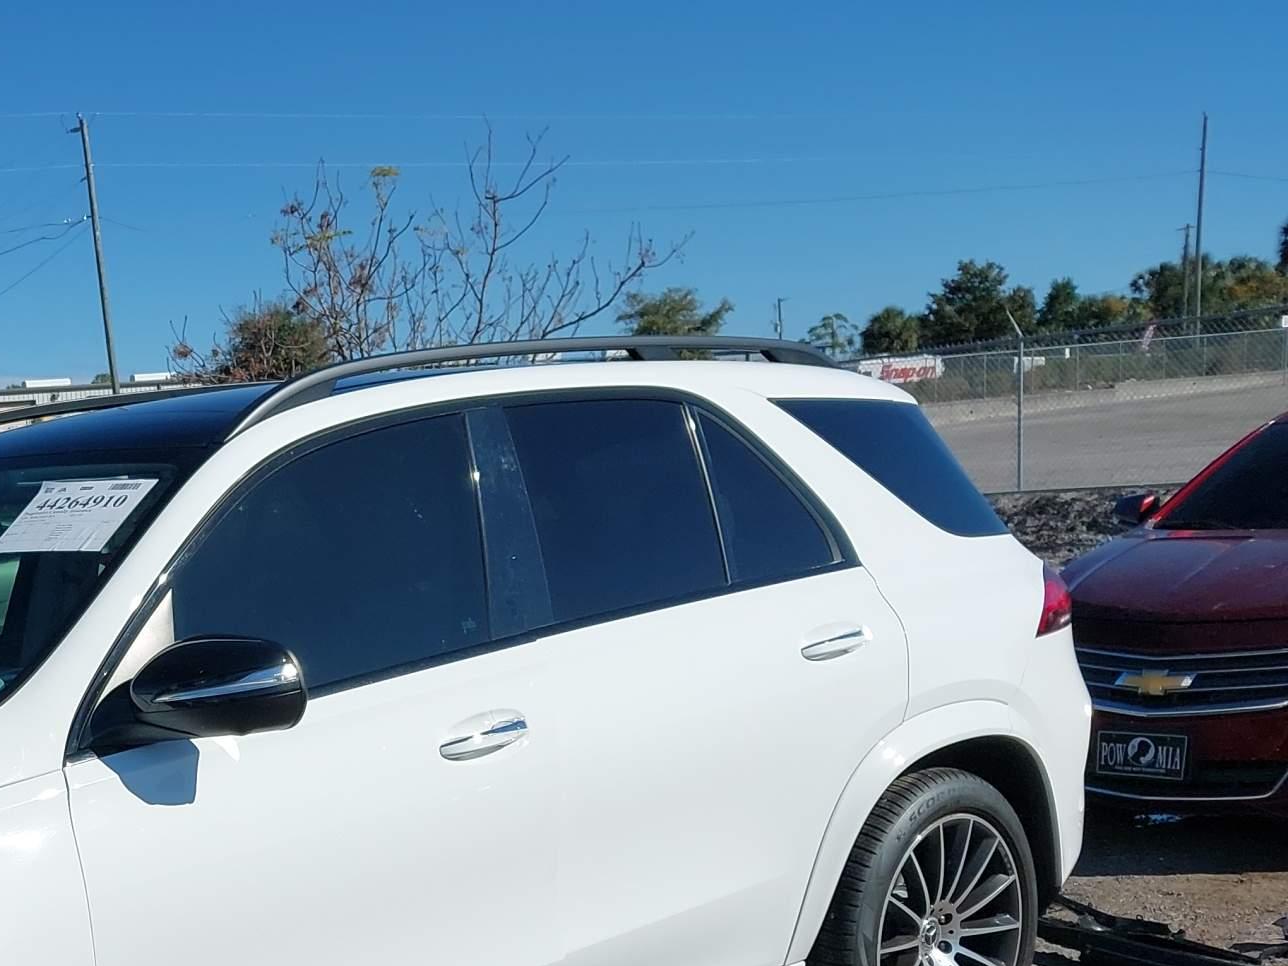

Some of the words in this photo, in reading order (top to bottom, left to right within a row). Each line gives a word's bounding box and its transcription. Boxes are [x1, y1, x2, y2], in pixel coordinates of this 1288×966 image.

[34, 494, 129, 511] 44264910
[1100, 741, 1128, 766] POW
[1155, 745, 1181, 770] MIA
